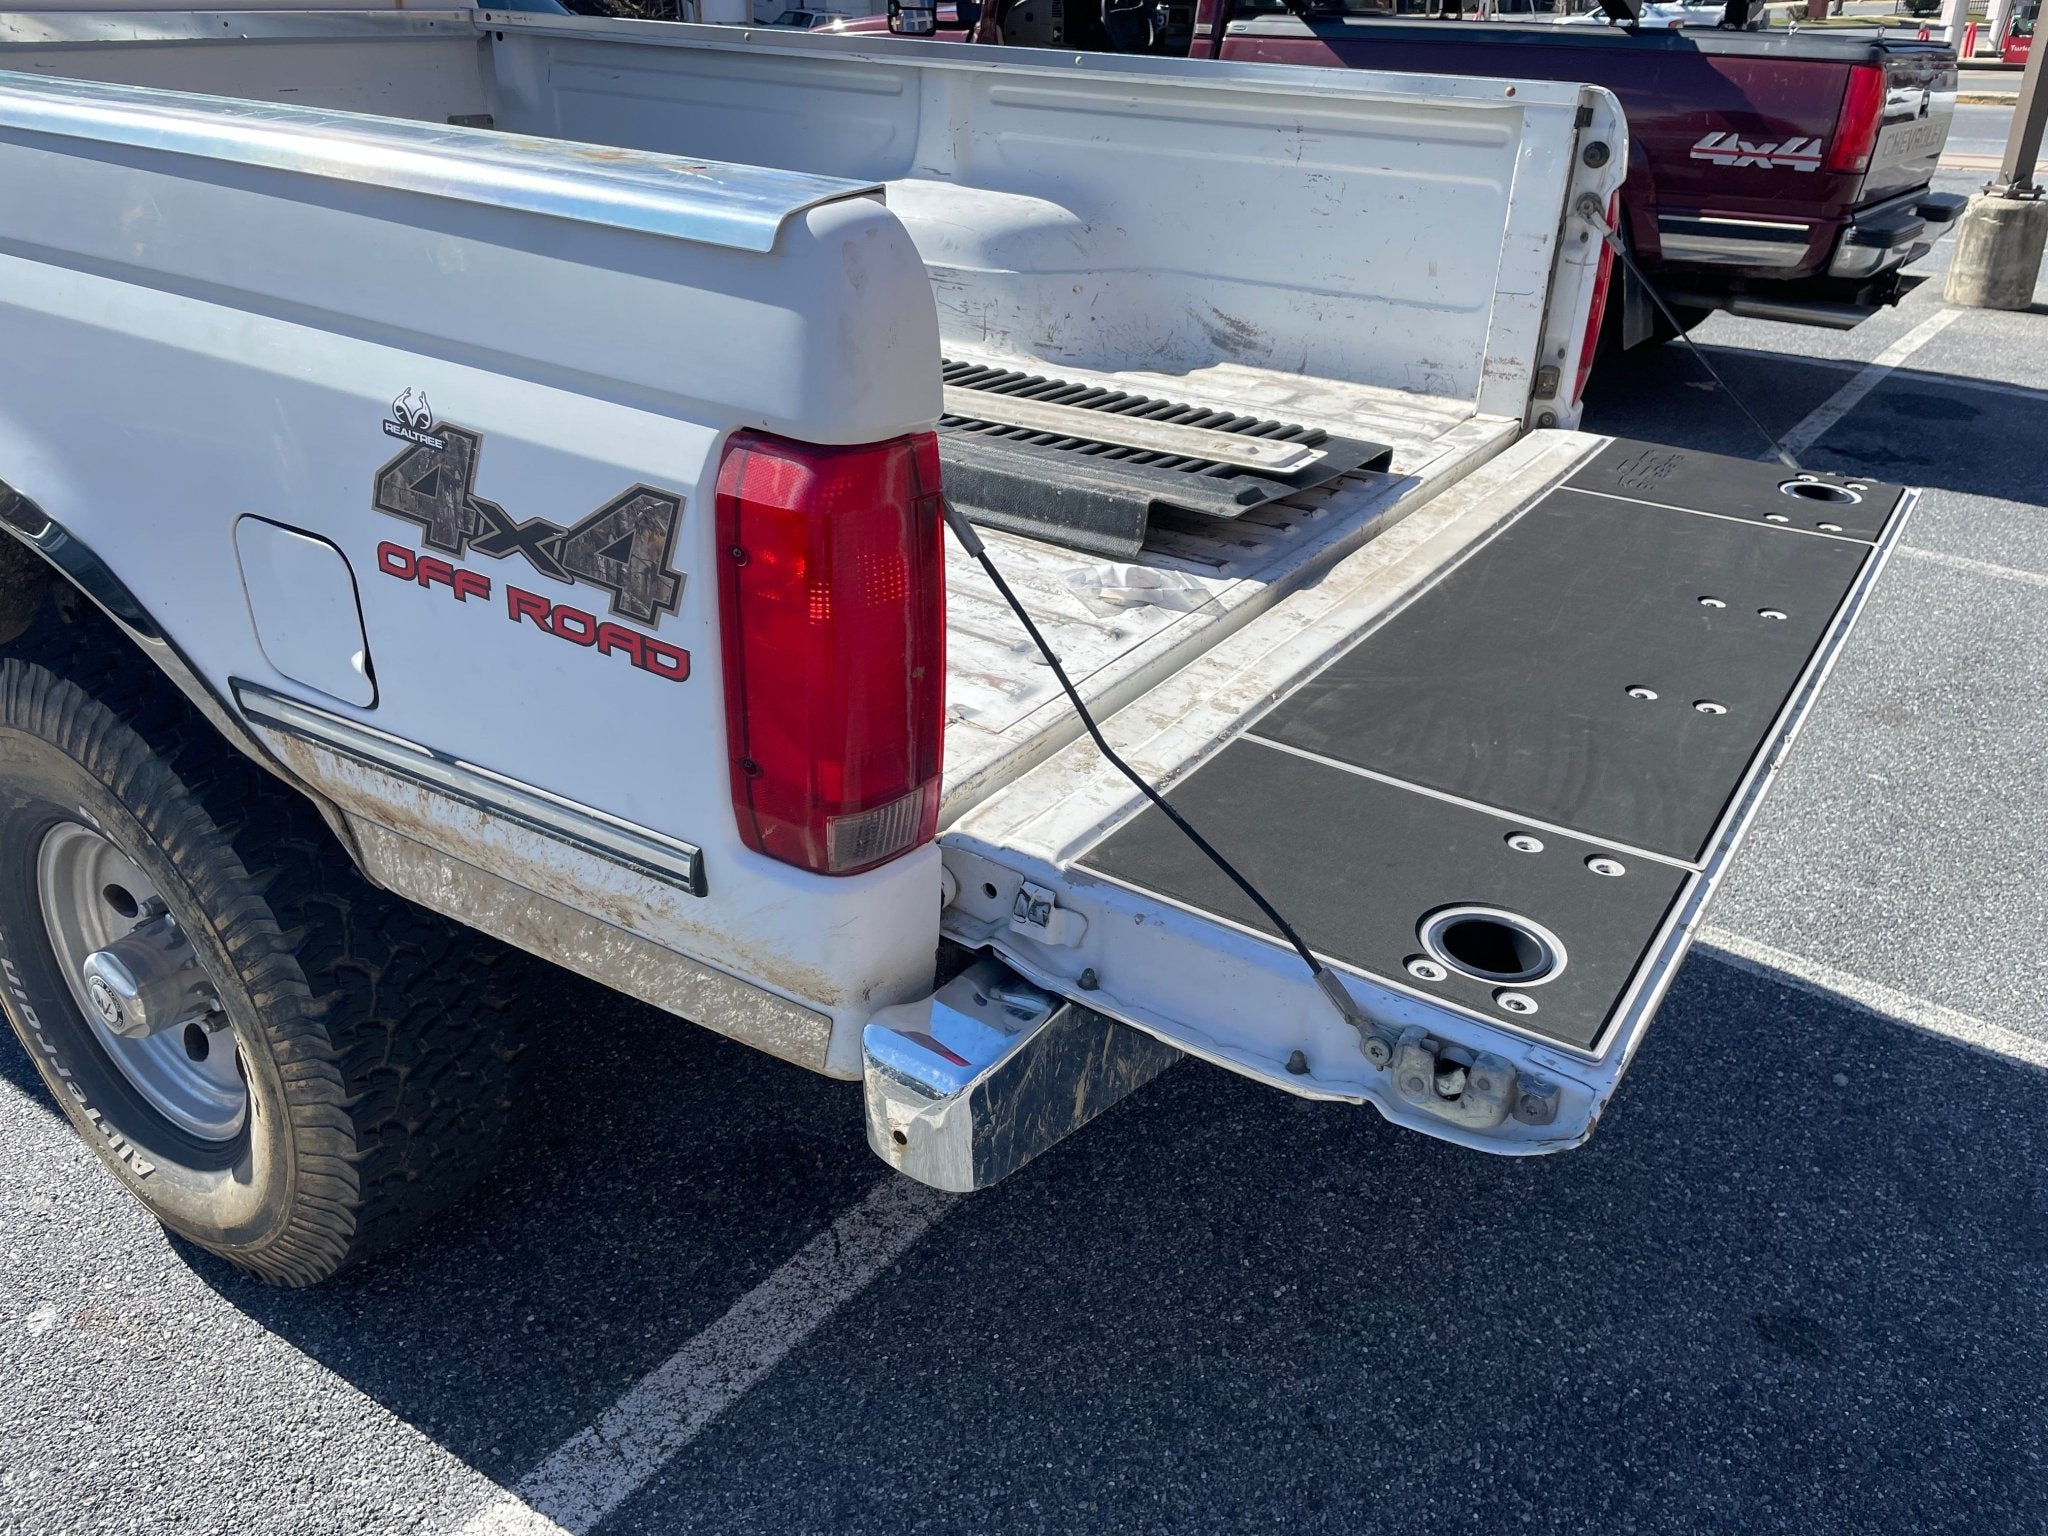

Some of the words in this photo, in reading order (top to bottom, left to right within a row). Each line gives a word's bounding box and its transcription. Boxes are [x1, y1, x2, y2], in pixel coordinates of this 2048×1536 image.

[1882, 123, 1945, 157] CHEVROLET
[384, 421, 445, 450] REALTREE
[377, 541, 491, 602] OFF
[506, 584, 690, 682] ROAD
